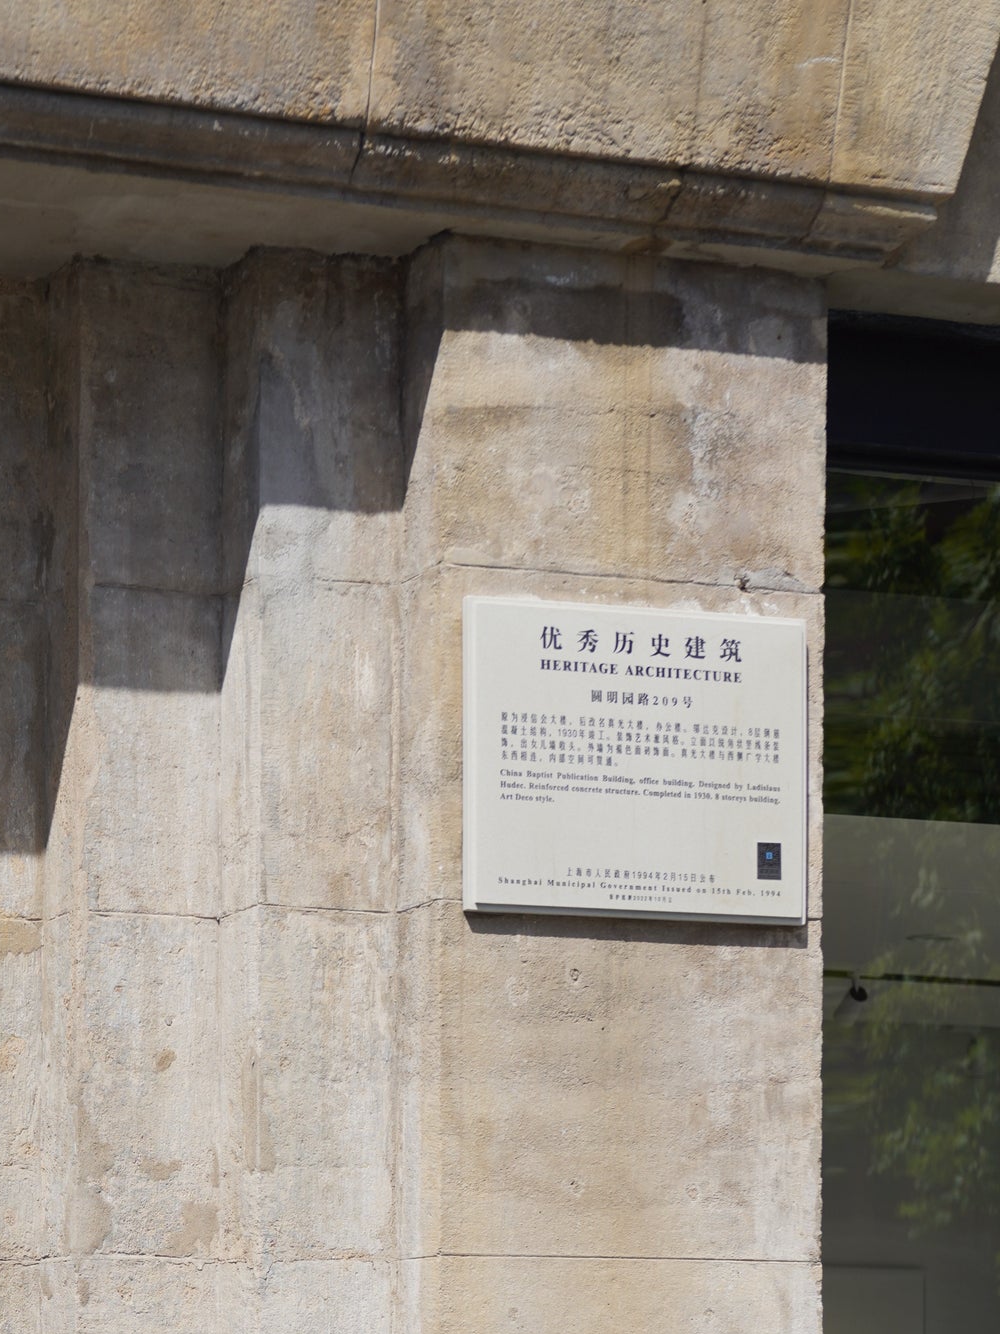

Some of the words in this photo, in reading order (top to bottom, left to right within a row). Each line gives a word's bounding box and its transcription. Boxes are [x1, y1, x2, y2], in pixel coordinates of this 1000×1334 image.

[540, 626, 742, 663] 优秀历史建筑
[540, 659, 619, 675] HERITAGE
[625, 665, 742, 683] ARCHITECTURE
[500, 768, 522, 777] China
[526, 770, 553, 780] Baptist
[557, 772, 599, 782] Publication
[639, 777, 659, 785] office
[698, 780, 731, 790] Designed
[734, 782, 743, 791] by
[747, 783, 781, 792] Ladislaus
[500, 780, 526, 789] Hudec.
[529, 782, 569, 792] Reinforced
[571, 785, 602, 794] concrete
[605, 786, 641, 796] structure.
[643, 789, 682, 799] Completed
[684, 791, 691, 799] in
[721, 794, 747, 803] storeys
[500, 792, 513, 801] Art
[515, 793, 534, 802] Deco
[535, 795, 555, 804] style.
[497, 876, 542, 886] Shanghai
[547, 879, 596, 889] Municipal
[600, 881, 657, 892] Government
[662, 885, 692, 893] Issued
[711, 887, 731, 895] 15th
[736, 889, 756, 897] Feb.
[760, 889, 781, 898] 1994
[566, 867, 716, 884] 上海市人民政府1994年2月15日公布
